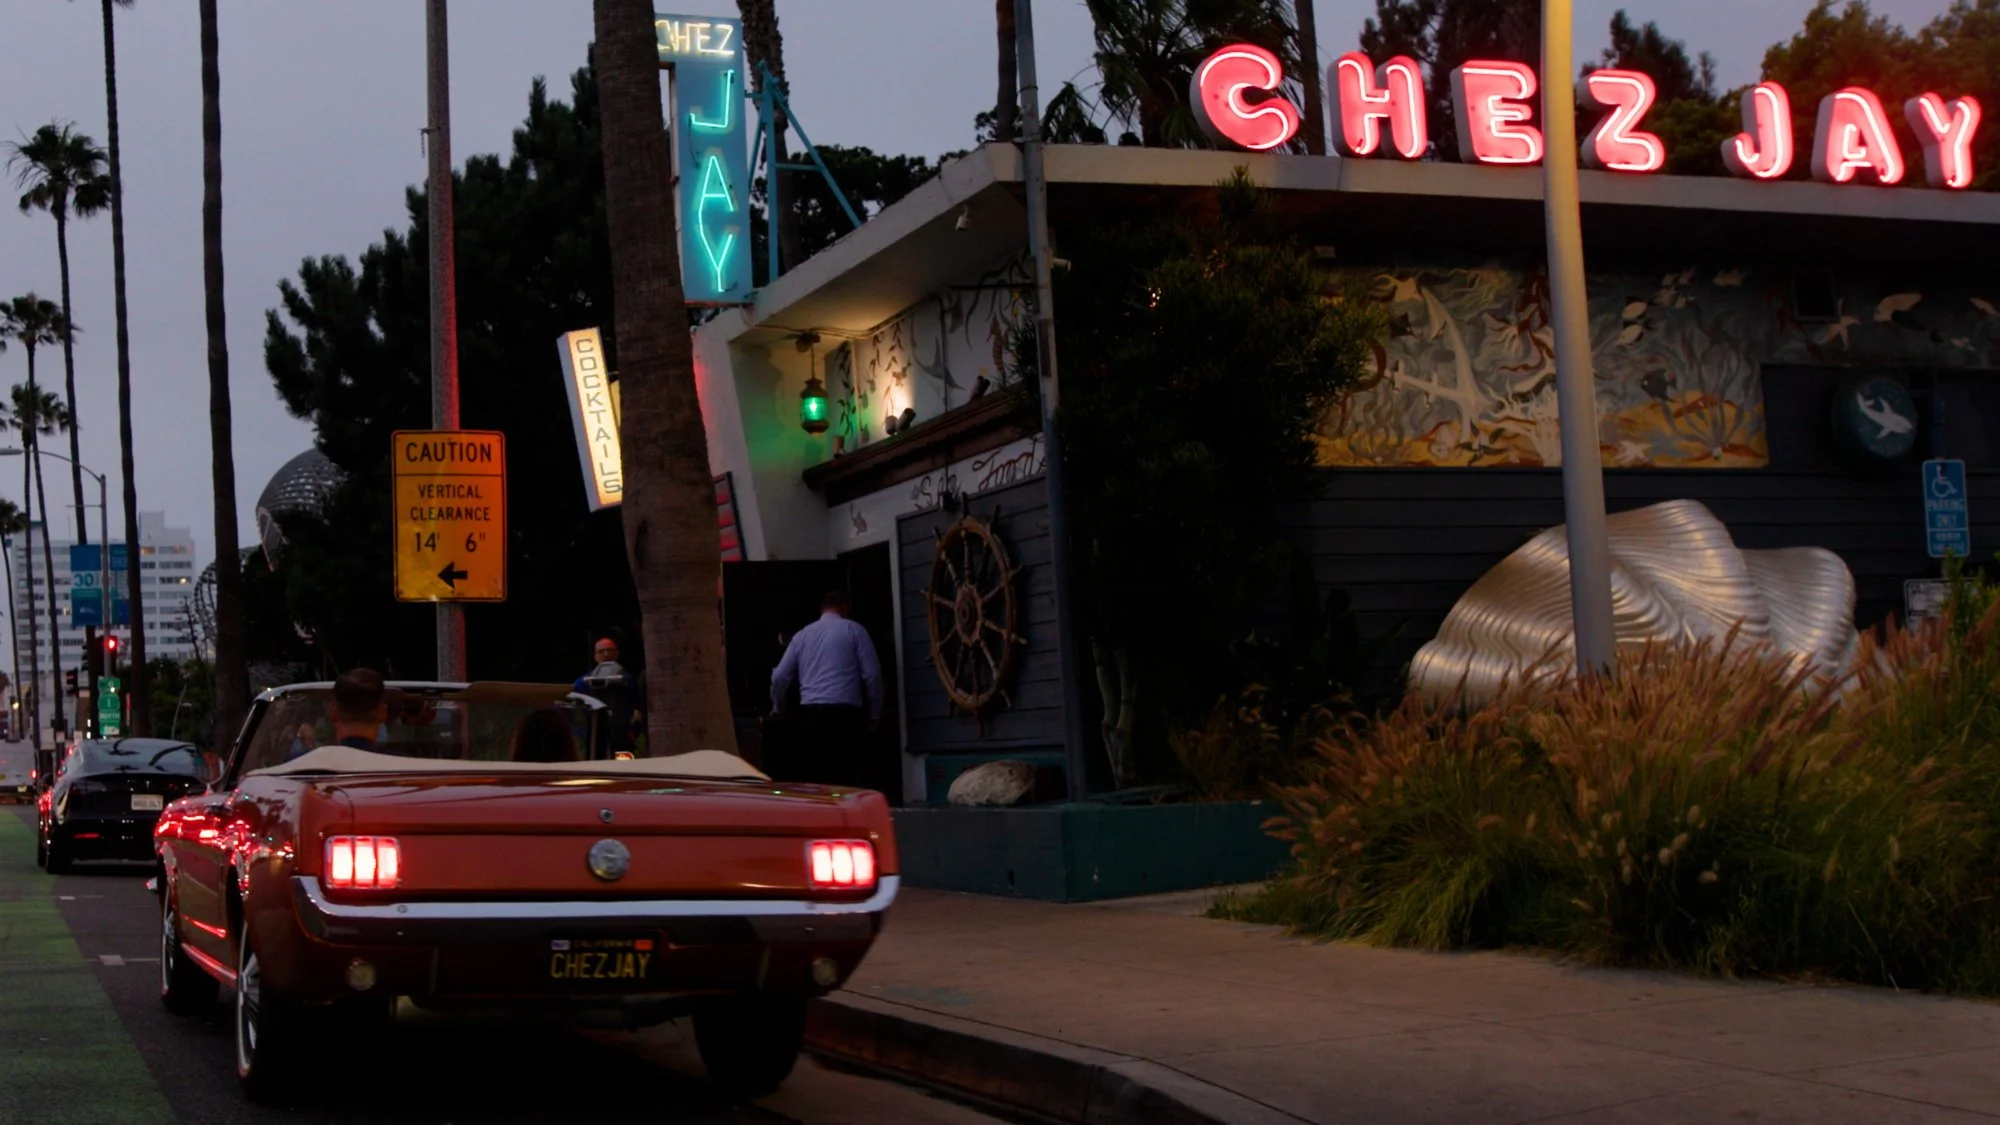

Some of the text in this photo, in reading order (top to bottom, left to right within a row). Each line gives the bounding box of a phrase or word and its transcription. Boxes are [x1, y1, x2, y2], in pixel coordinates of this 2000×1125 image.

[655, 20, 735, 55] CHEZ
[1190, 43, 1982, 189] CHEZ JAY
[690, 69, 735, 292] JAY
[575, 338, 623, 494] COCKTAILS
[406, 442, 492, 463] CAUTION
[418, 484, 483, 499] VERTICAL
[410, 506, 491, 521] CLEARANCE
[415, 532, 486, 552] 14' 6"
[73, 572, 94, 587] 30
[550, 952, 652, 978] CHEZJAY
